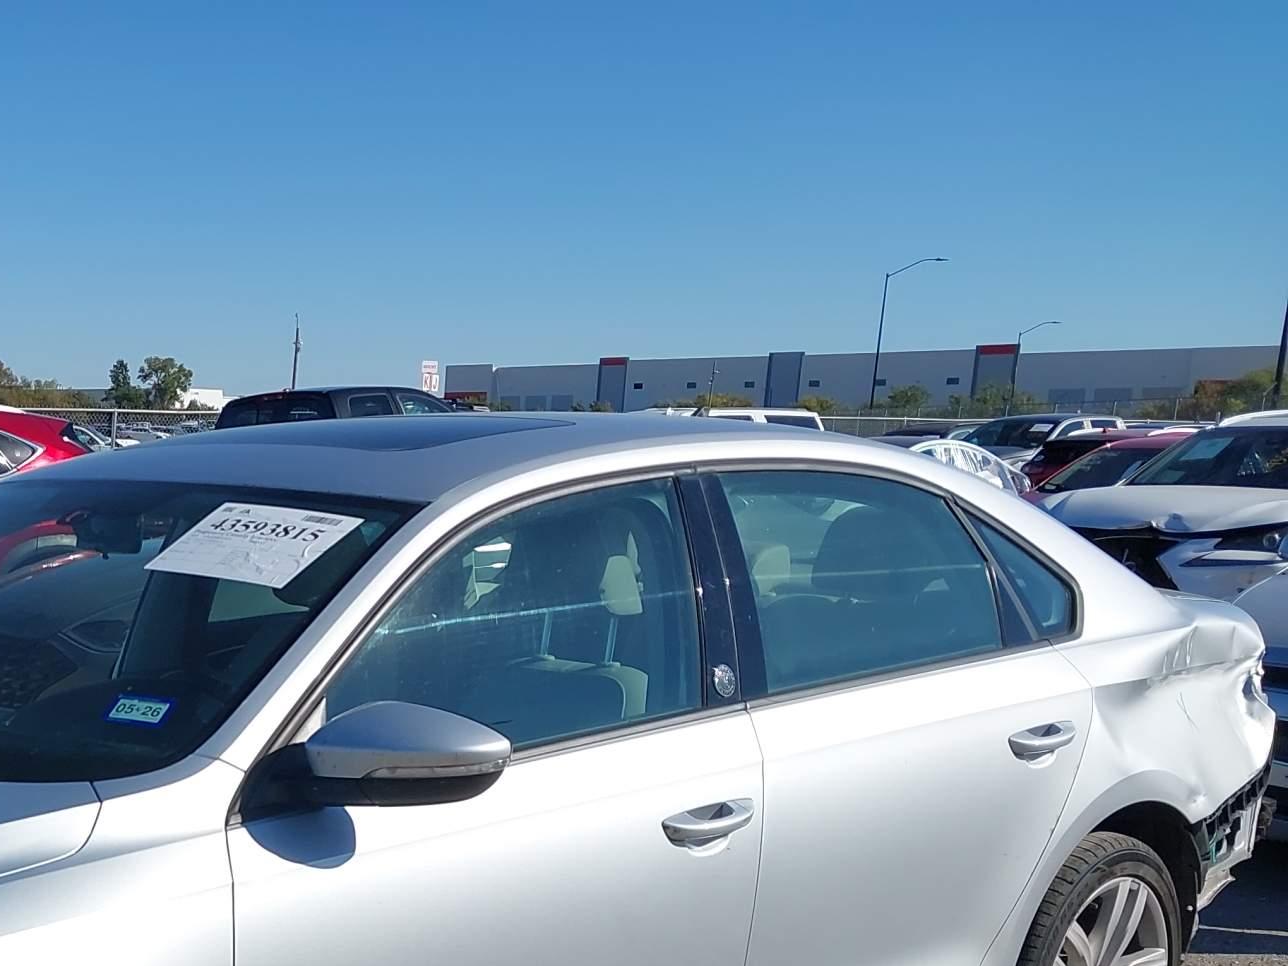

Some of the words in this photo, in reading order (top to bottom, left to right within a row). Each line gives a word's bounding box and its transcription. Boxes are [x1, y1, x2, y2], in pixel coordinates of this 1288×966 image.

[210, 517, 326, 543] 43593815
[115, 703, 137, 714] 05
[141, 706, 162, 717] 26
